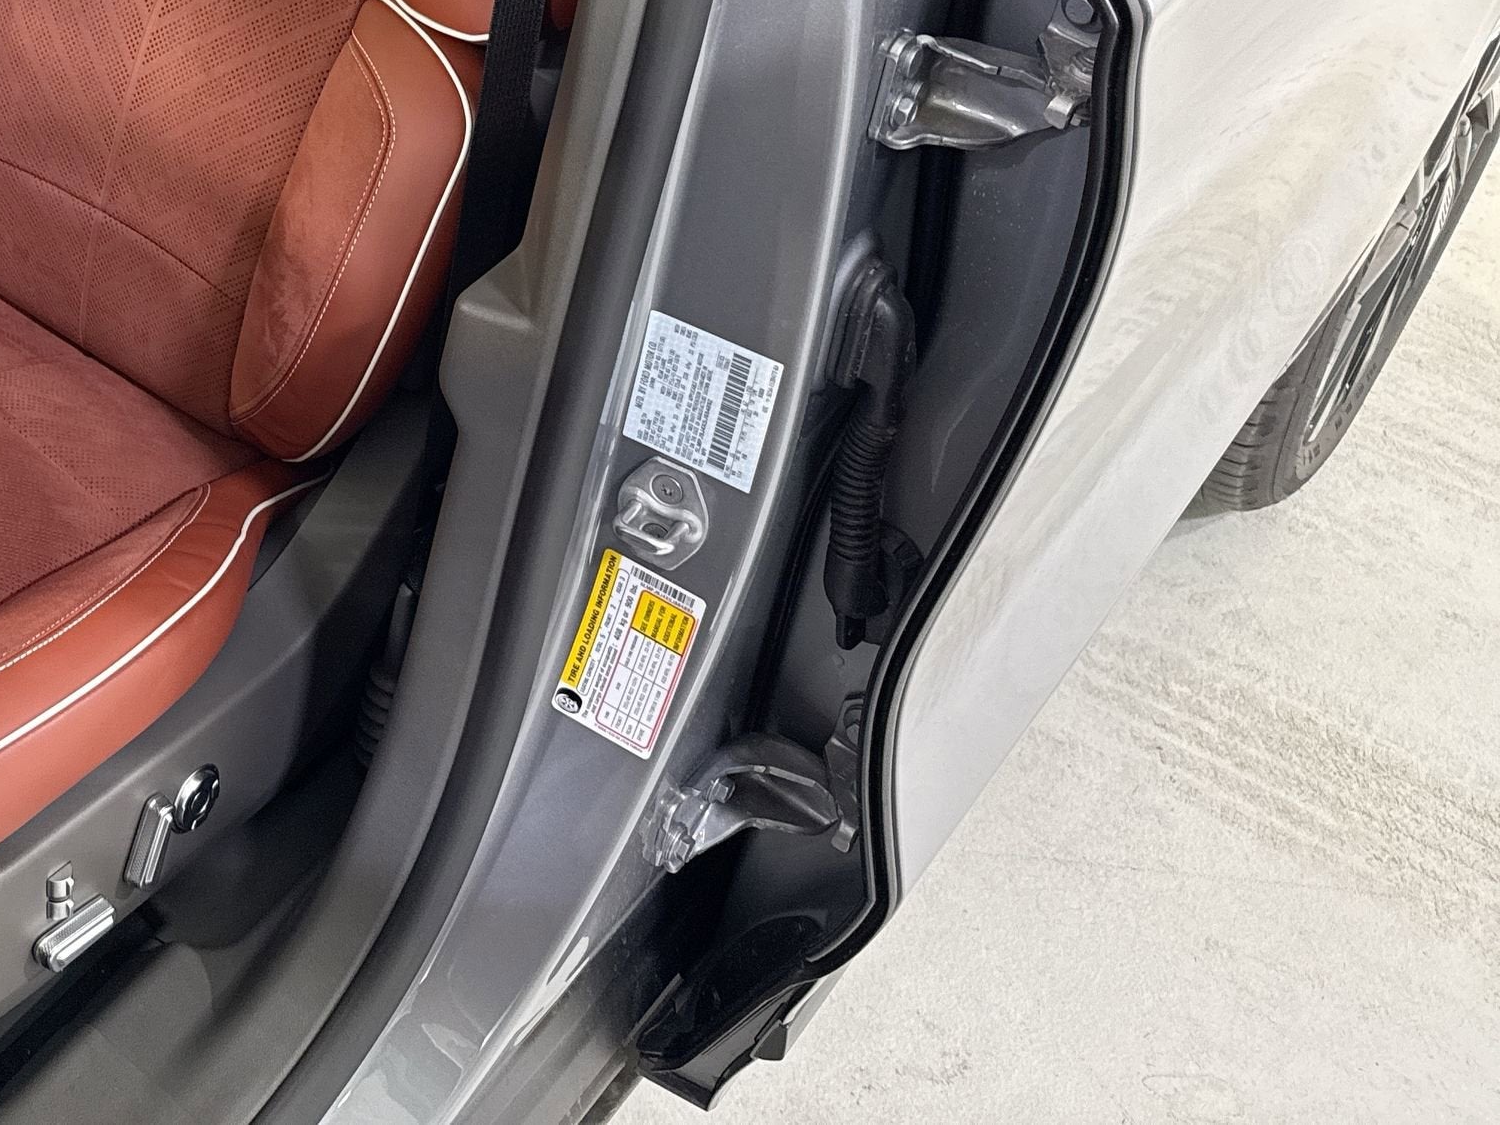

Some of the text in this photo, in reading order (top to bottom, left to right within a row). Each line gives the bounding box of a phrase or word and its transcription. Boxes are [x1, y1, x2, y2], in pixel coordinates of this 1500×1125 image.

[644, 349, 655, 371] MOTOR
[639, 370, 651, 387] FORD
[637, 385, 647, 395] BY
[624, 595, 634, 609] 900
[567, 554, 617, 683] TIRE AND LOADING INFORMATION
[622, 610, 629, 619] or
[618, 617, 628, 628] kg
[613, 627, 623, 641] 408
